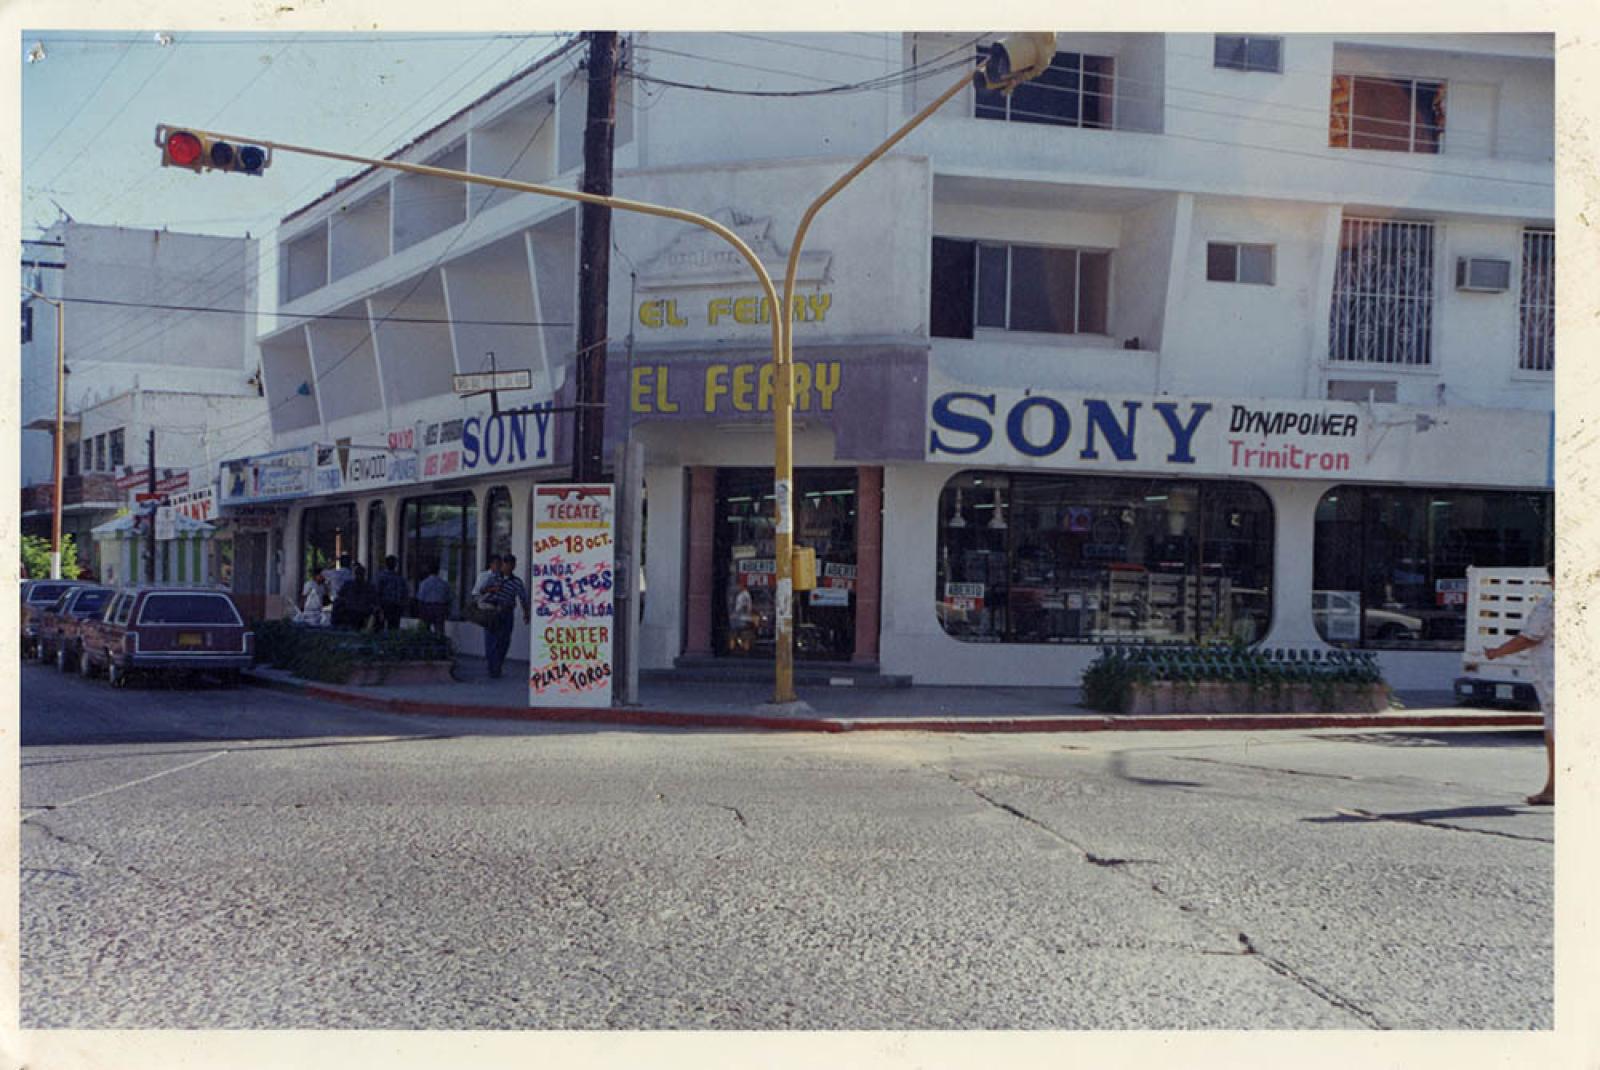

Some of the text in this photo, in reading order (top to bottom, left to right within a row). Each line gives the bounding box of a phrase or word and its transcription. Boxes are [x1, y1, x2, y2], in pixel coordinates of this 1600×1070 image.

[639, 299, 688, 328] EL
[630, 366, 678, 412] EL
[462, 401, 553, 469] SONY
[929, 391, 1212, 465] SONY
[1229, 404, 1358, 439] DYNAPOWER
[1228, 440, 1350, 471] Trinitron
[546, 503, 601, 519] TECATE
[533, 563, 574, 577] BANDA
[561, 602, 613, 617] SINALOA
[544, 626, 609, 644] CENTER
[550, 645, 598, 660] SHOW
[569, 663, 610, 689] TOROS
